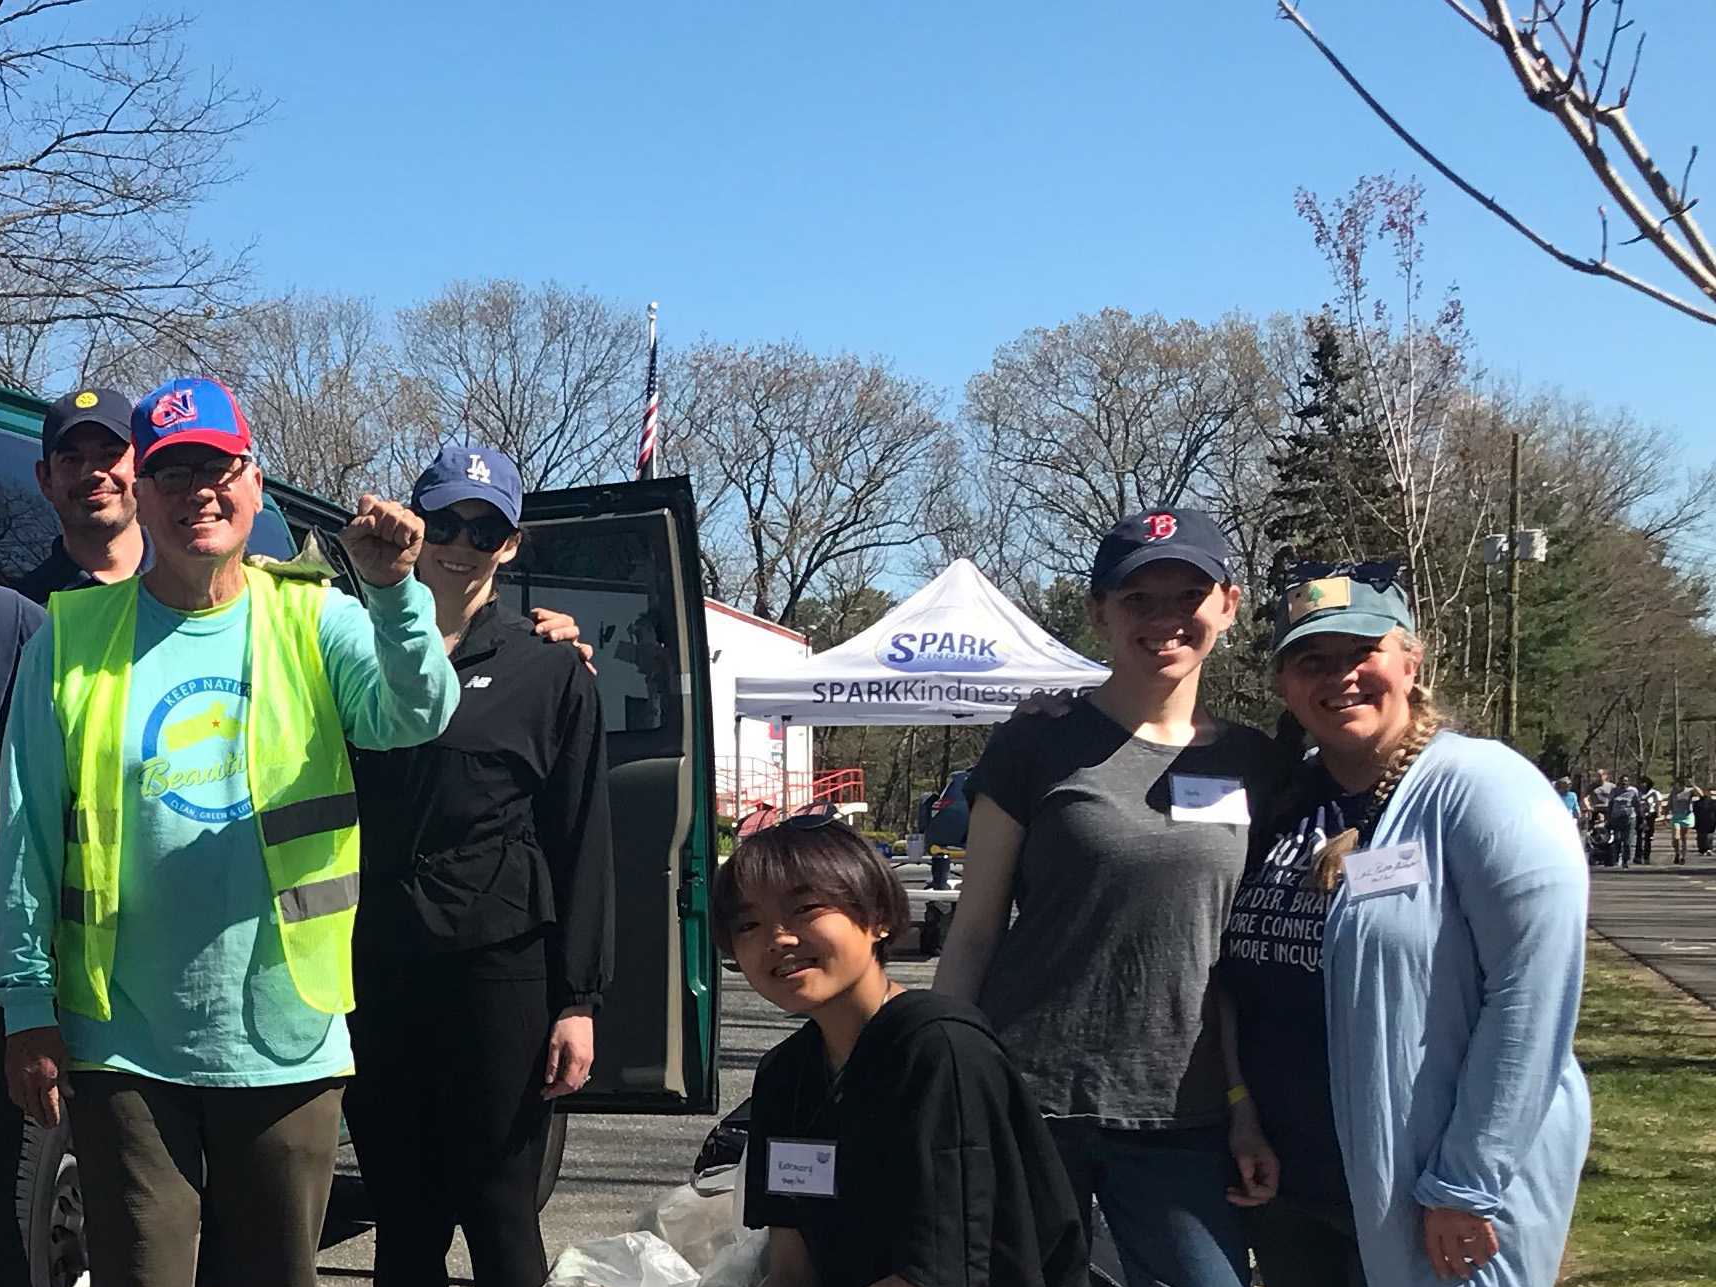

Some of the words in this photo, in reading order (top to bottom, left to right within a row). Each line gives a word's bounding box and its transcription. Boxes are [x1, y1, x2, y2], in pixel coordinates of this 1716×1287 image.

[466, 454, 492, 485] LA
[1143, 512, 1178, 542] B
[887, 631, 998, 663] SPARK
[163, 681, 197, 708] KEEP
[1229, 939, 1269, 965] MORE
